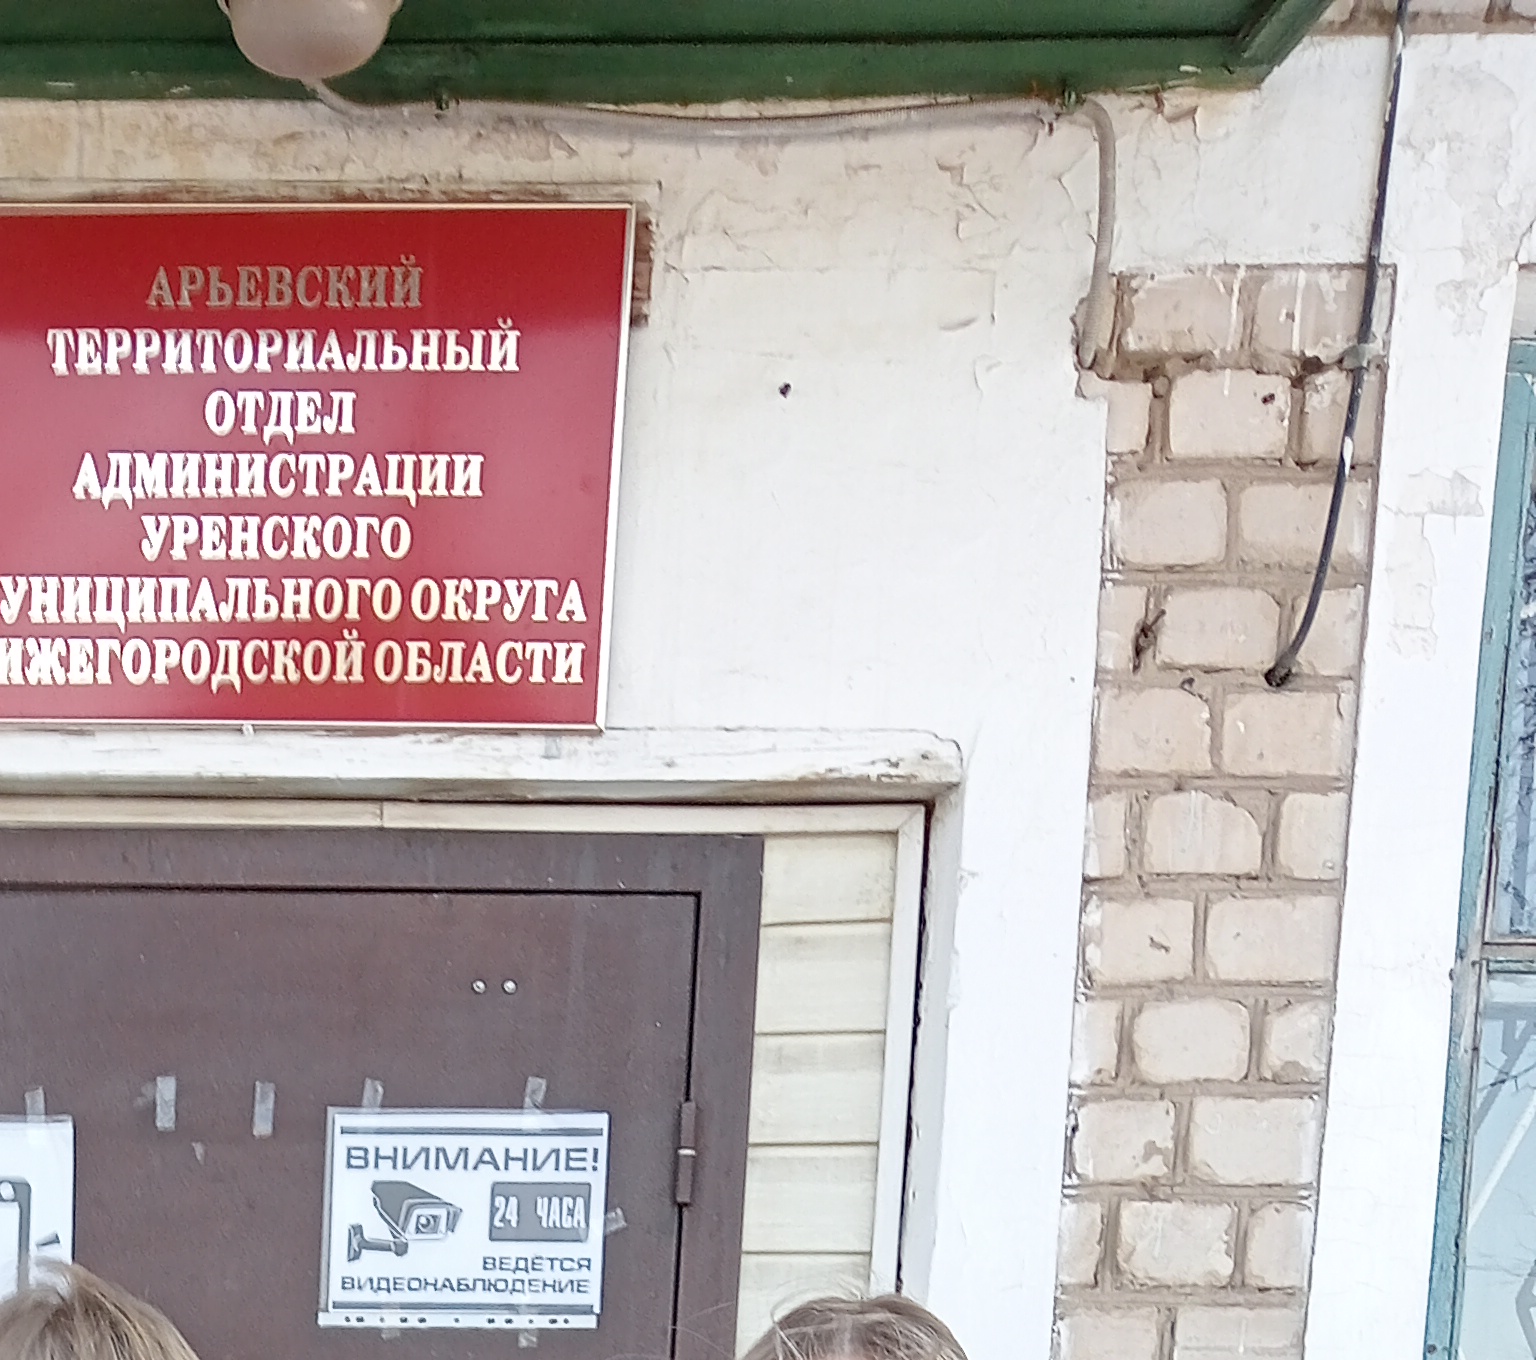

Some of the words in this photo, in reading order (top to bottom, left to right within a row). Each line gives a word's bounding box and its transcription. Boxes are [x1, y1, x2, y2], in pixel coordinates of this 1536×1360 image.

[147, 255, 423, 309] АРЬЕВСКИЙ
[47, 318, 522, 376] ТЕРРИТОРИАЛЬНЫЙ
[204, 389, 357, 445] ОТДЕЛ
[72, 453, 485, 509] АДМИНИСТРАЦИИ
[140, 514, 411, 561] УРЕНСКОГО
[410, 579, 588, 623] ОКРУГА
[380, 641, 585, 685] ОБЛАСТИ
[345, 1146, 599, 1172] ВНИМАНИЕ!
[494, 1195, 518, 1228] 24
[536, 1195, 588, 1228] ЧАСА
[341, 1276, 591, 1295] ВИДЕОНАБЛЮДЕНИЕ
